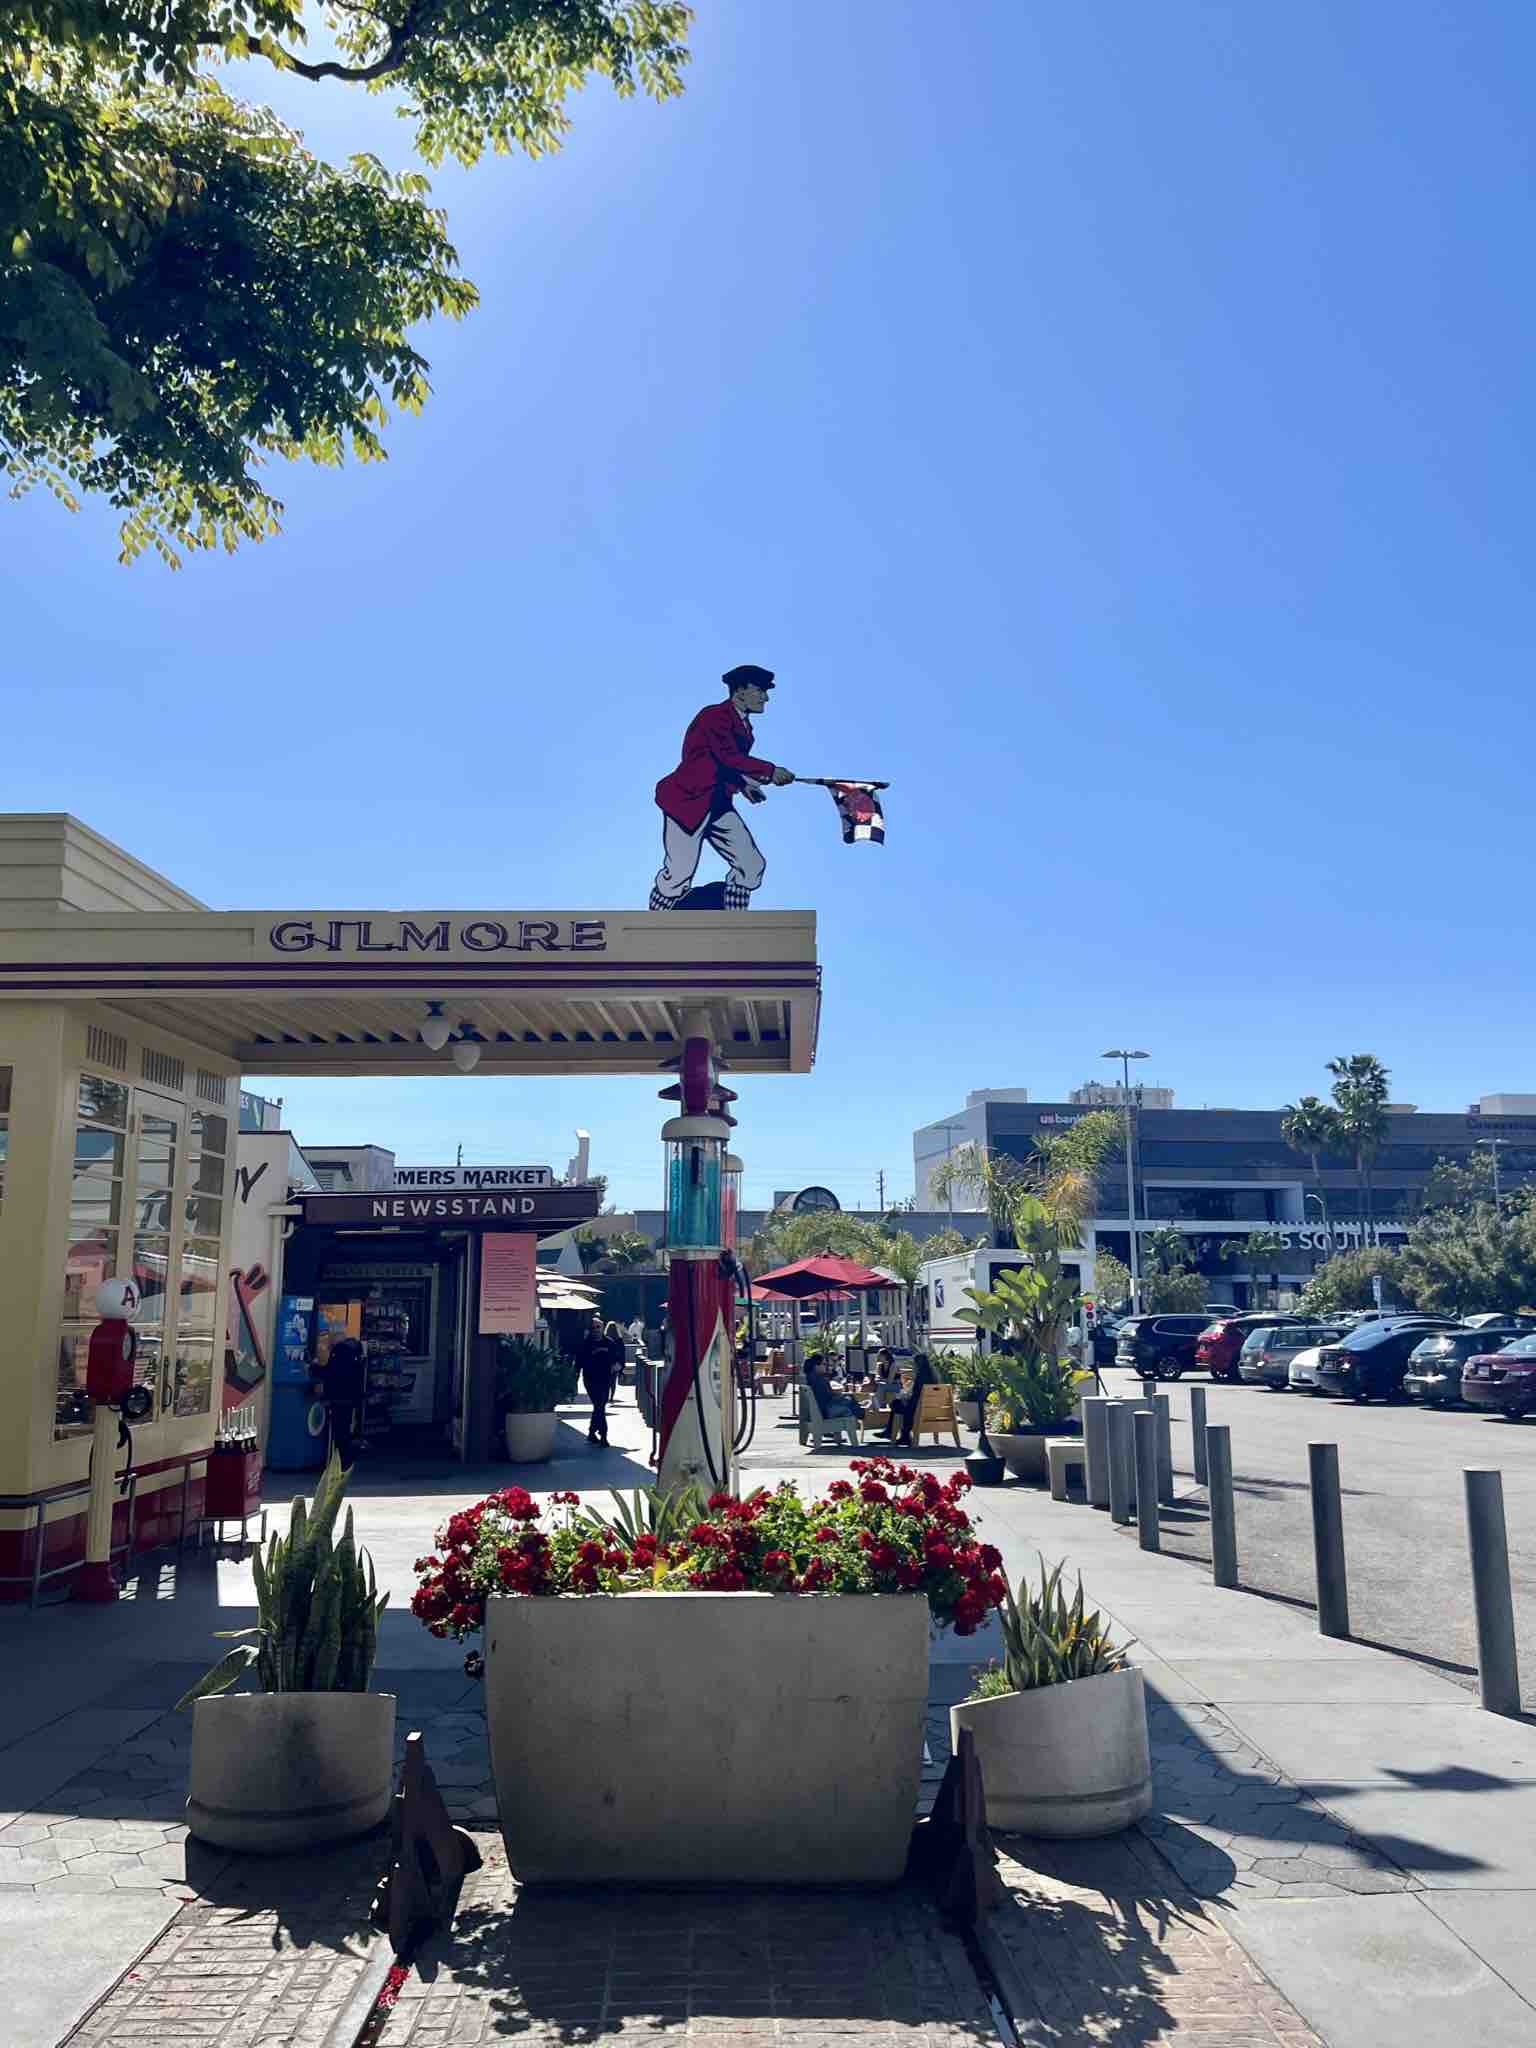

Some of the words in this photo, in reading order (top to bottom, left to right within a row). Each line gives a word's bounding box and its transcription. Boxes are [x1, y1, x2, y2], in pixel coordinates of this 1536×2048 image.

[270, 920, 608, 952] GILMORE
[393, 1169, 456, 1186] MERS
[463, 1169, 548, 1186] MARKET
[372, 1197, 536, 1218] NEWSSTAND
